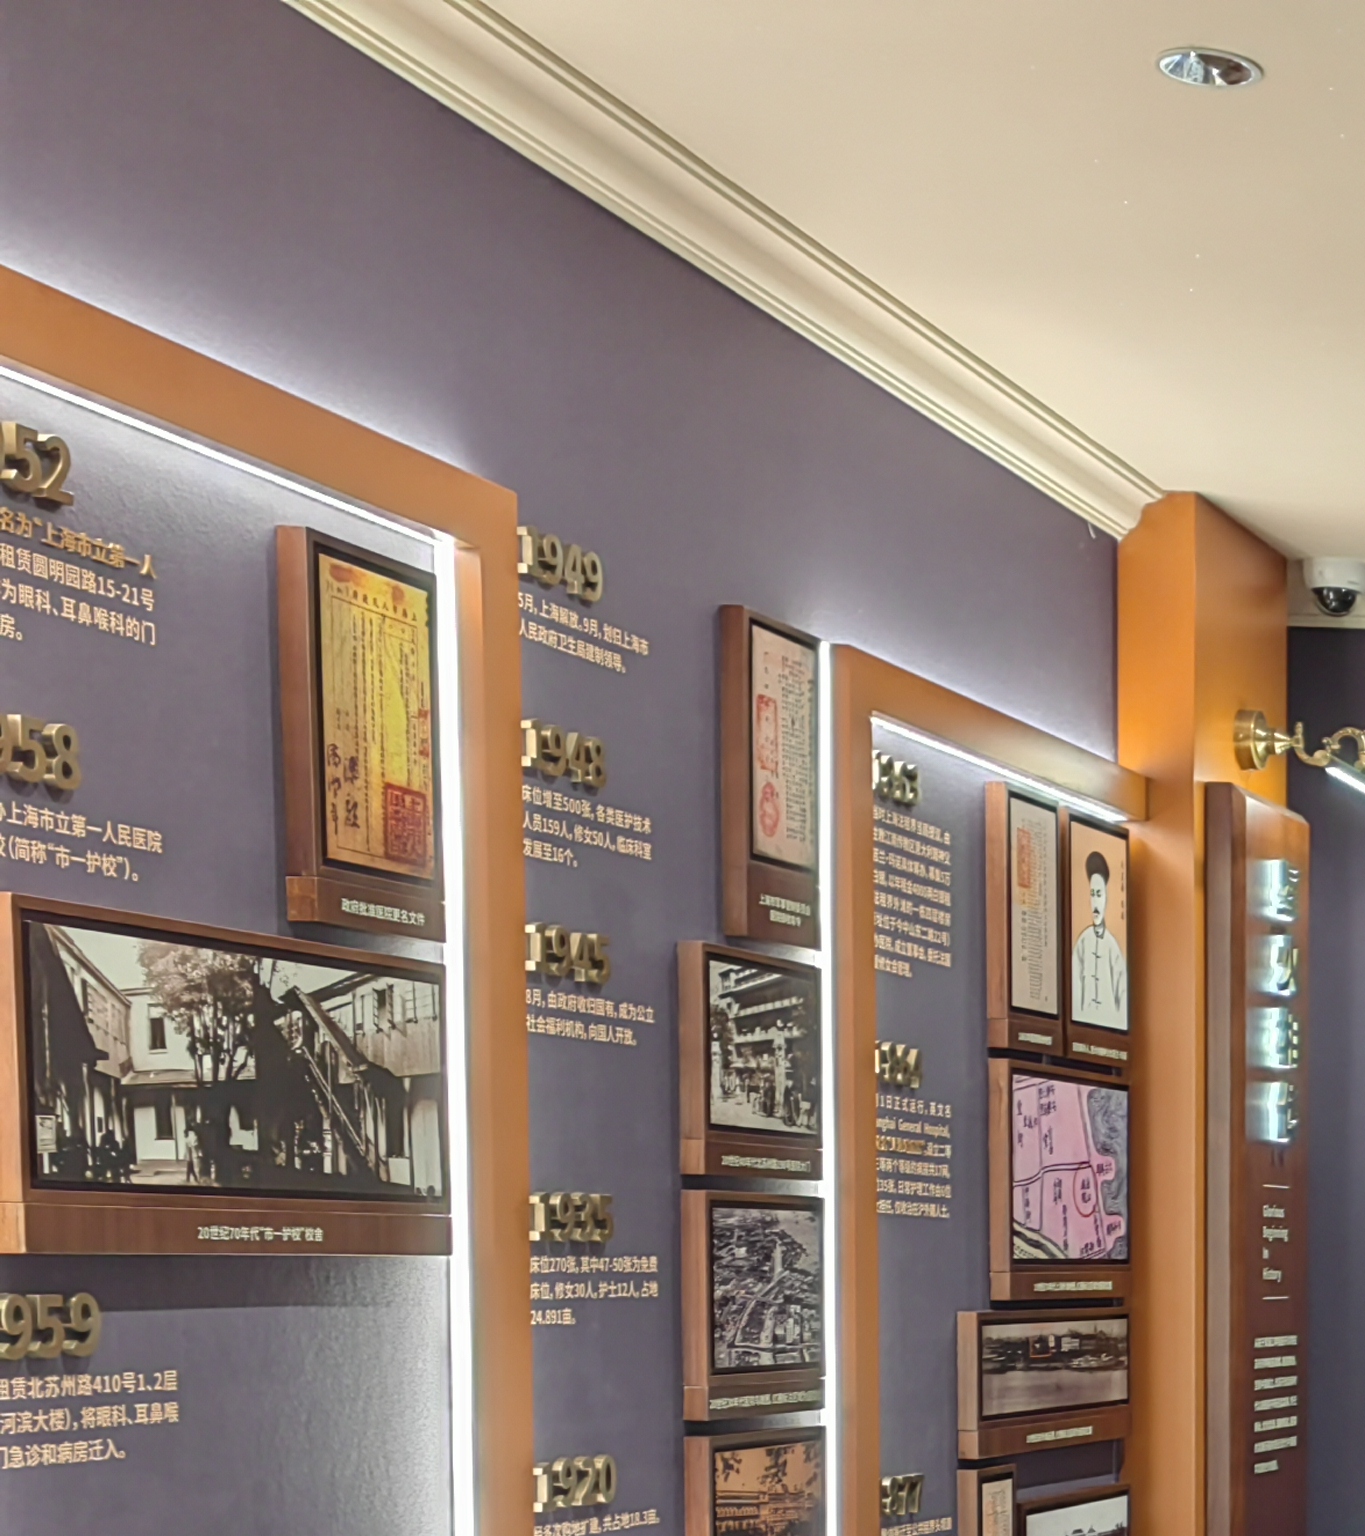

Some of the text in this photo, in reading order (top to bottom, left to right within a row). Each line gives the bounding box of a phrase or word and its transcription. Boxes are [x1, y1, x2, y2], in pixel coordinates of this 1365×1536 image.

[0, 421, 75, 506] 52
[517, 526, 603, 602] 1949
[520, 718, 607, 789] 1948
[525, 922, 612, 987] 1945
[529, 1192, 614, 1243] 1935
[532, 1454, 618, 1513] 1920
